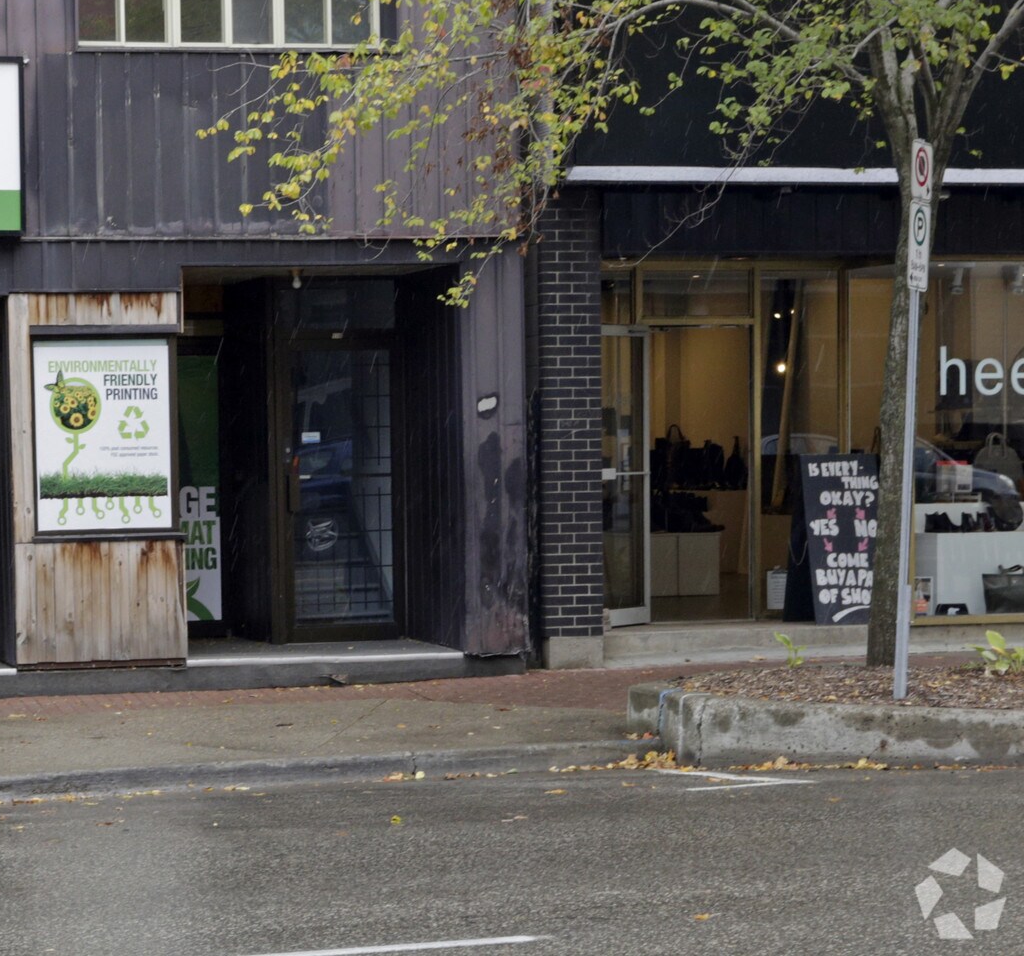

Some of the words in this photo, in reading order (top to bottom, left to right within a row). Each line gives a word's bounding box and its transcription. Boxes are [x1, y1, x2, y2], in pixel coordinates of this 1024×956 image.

[48, 359, 157, 373] ENVIRONMENTALLY
[103, 373, 158, 386] FRIENDLY
[105, 387, 158, 400] PRINTING
[841, 476, 879, 490] THING
[819, 490, 875, 507] OKAY?
[809, 519, 839, 536] YES
[854, 519, 877, 538] NO
[826, 552, 869, 568] COME
[815, 569, 845, 586] BUY
[857, 569, 873, 587] PA
[818, 588, 838, 604] OF
[841, 587, 872, 605] SHO
